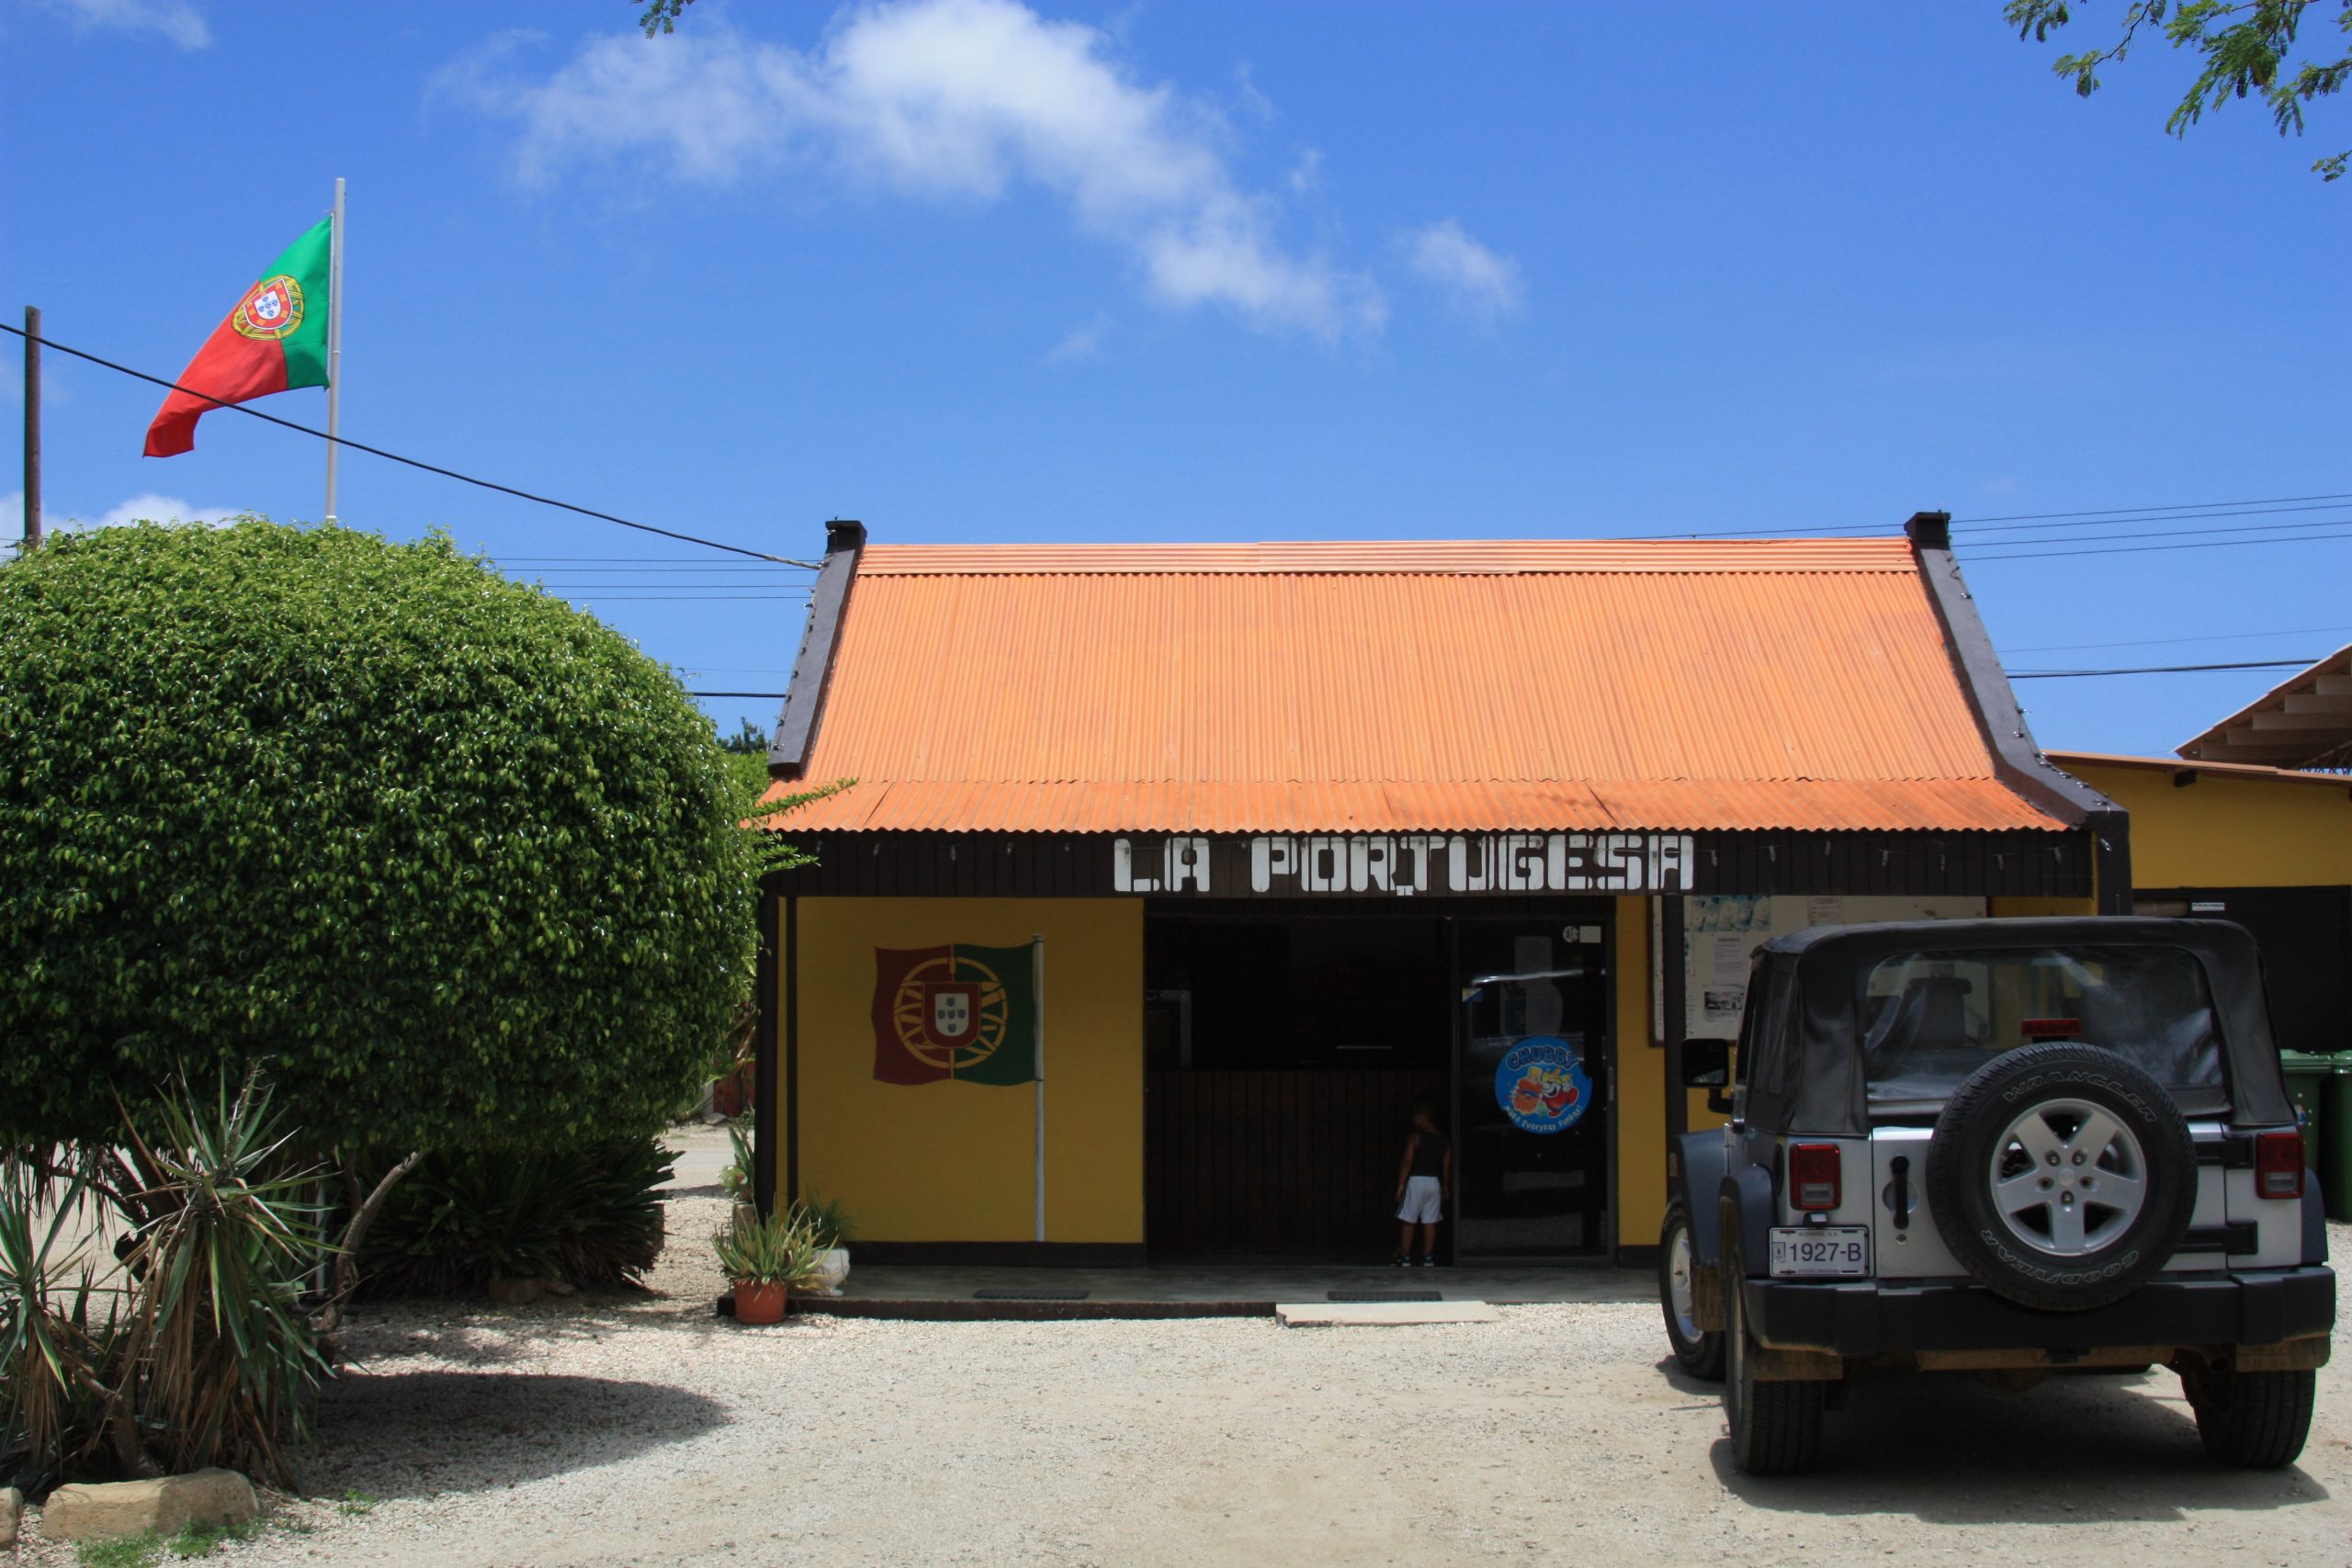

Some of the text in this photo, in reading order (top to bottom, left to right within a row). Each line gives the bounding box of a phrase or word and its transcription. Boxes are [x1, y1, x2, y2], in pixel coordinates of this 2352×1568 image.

[1114, 834, 1694, 895] LA PORTUGESA
[1506, 1045, 1578, 1071] CHUBBY
[2002, 1070, 2158, 1122] WRANGLER
[1789, 1242, 1861, 1262] 1927-B
[1980, 1229, 2139, 1285] GOODYEAR
